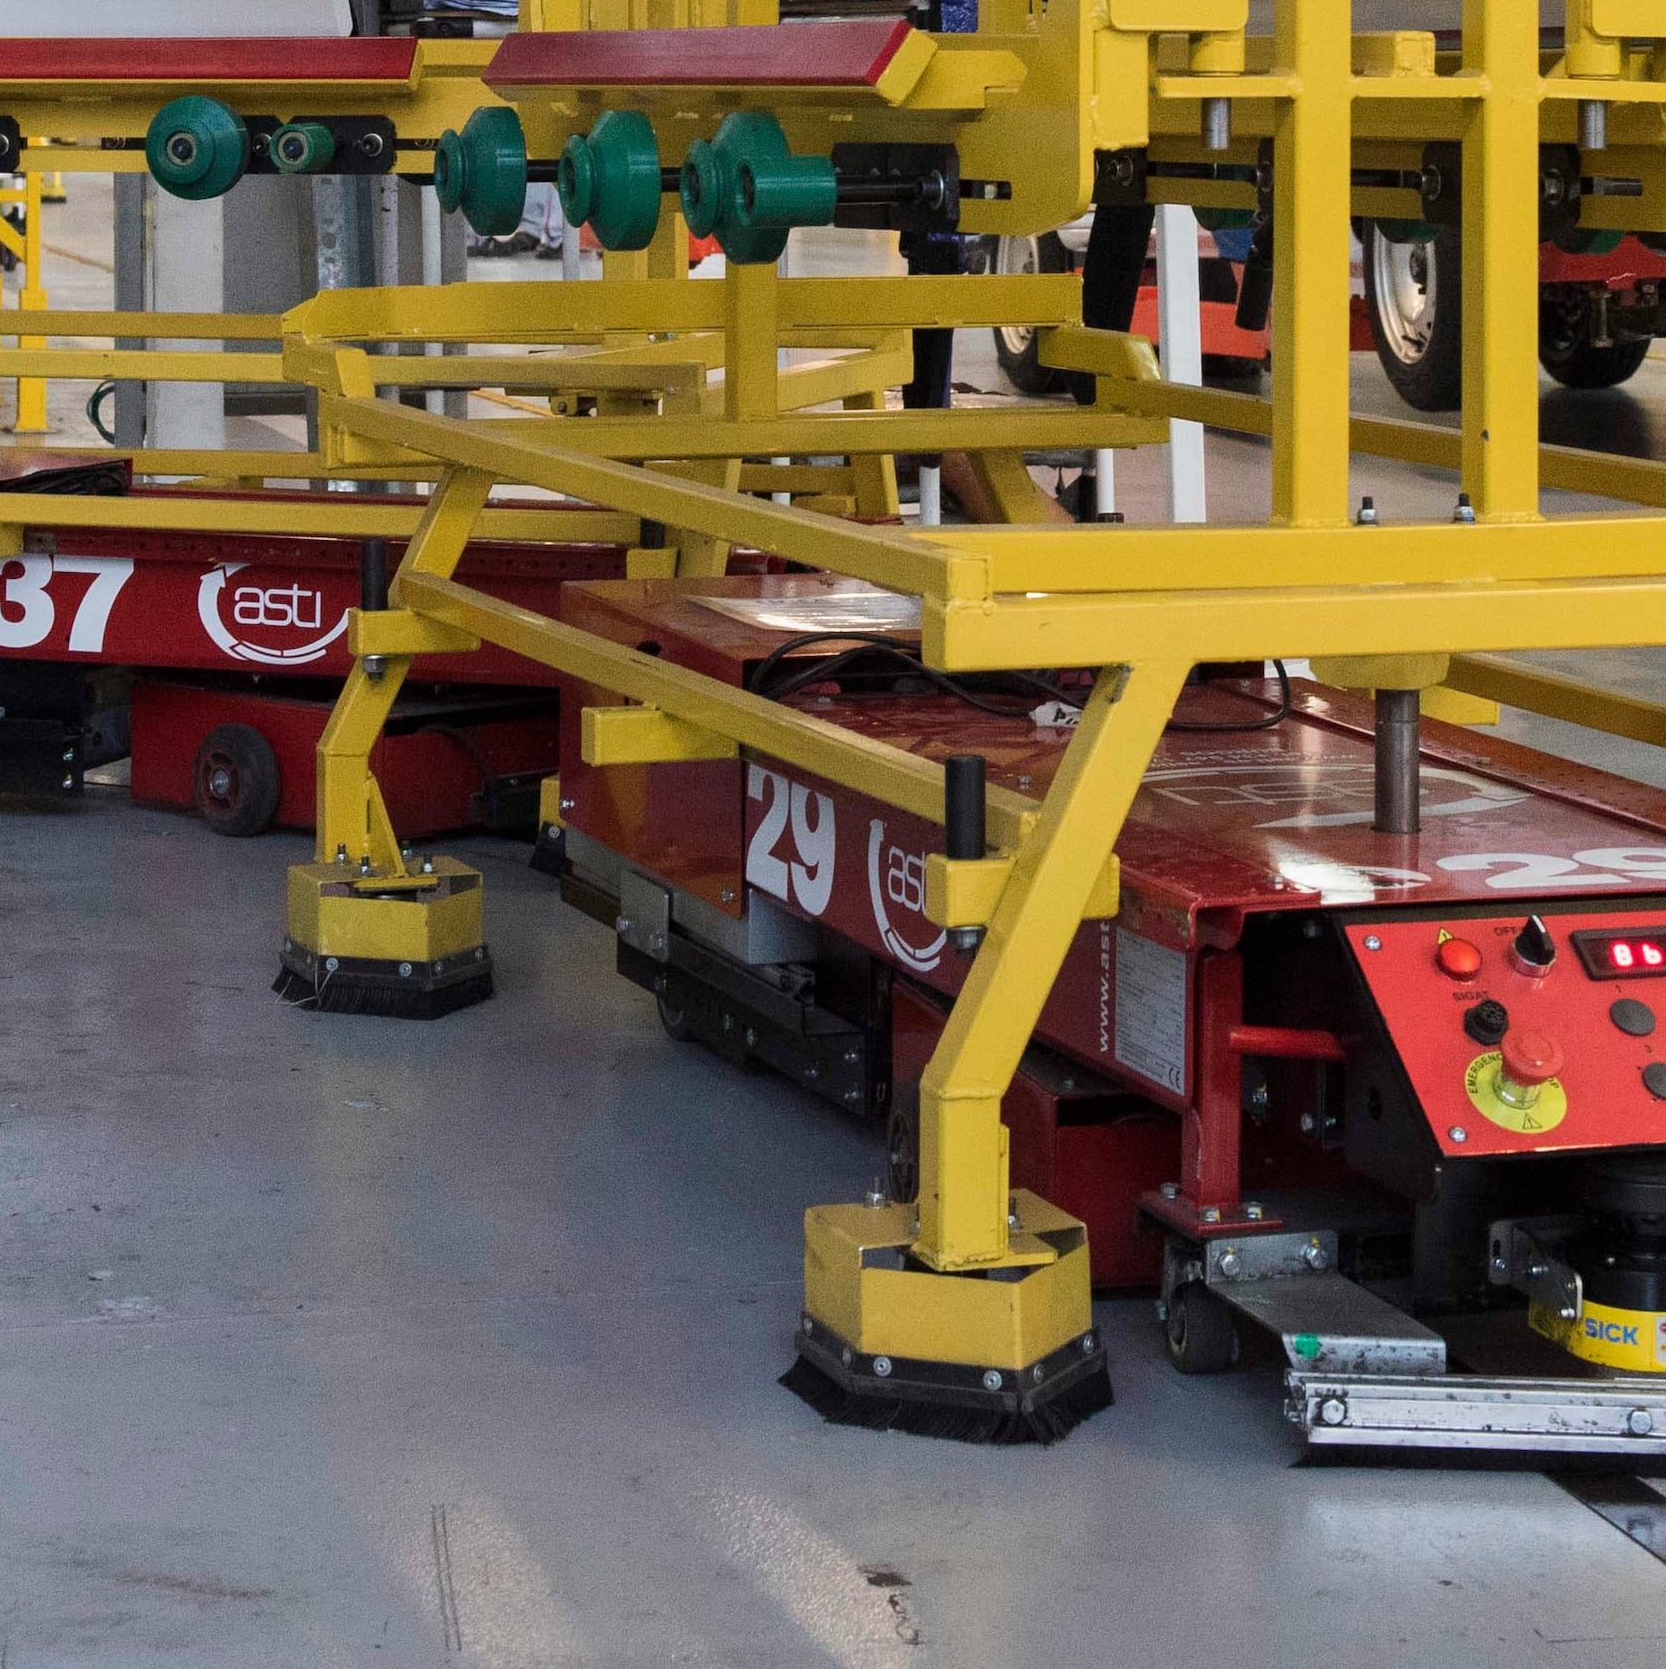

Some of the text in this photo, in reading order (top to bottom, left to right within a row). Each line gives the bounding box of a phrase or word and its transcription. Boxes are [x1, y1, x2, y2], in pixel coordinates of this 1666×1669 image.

[233, 583, 321, 628] asti
[745, 765, 835, 916] 29
[888, 845, 927, 917] ast
[1494, 926, 1517, 935] OFF
[1100, 921, 1110, 1052] www.ast
[1467, 1053, 1503, 1094] EMERGENC
[1585, 1317, 1639, 1346] SICK
